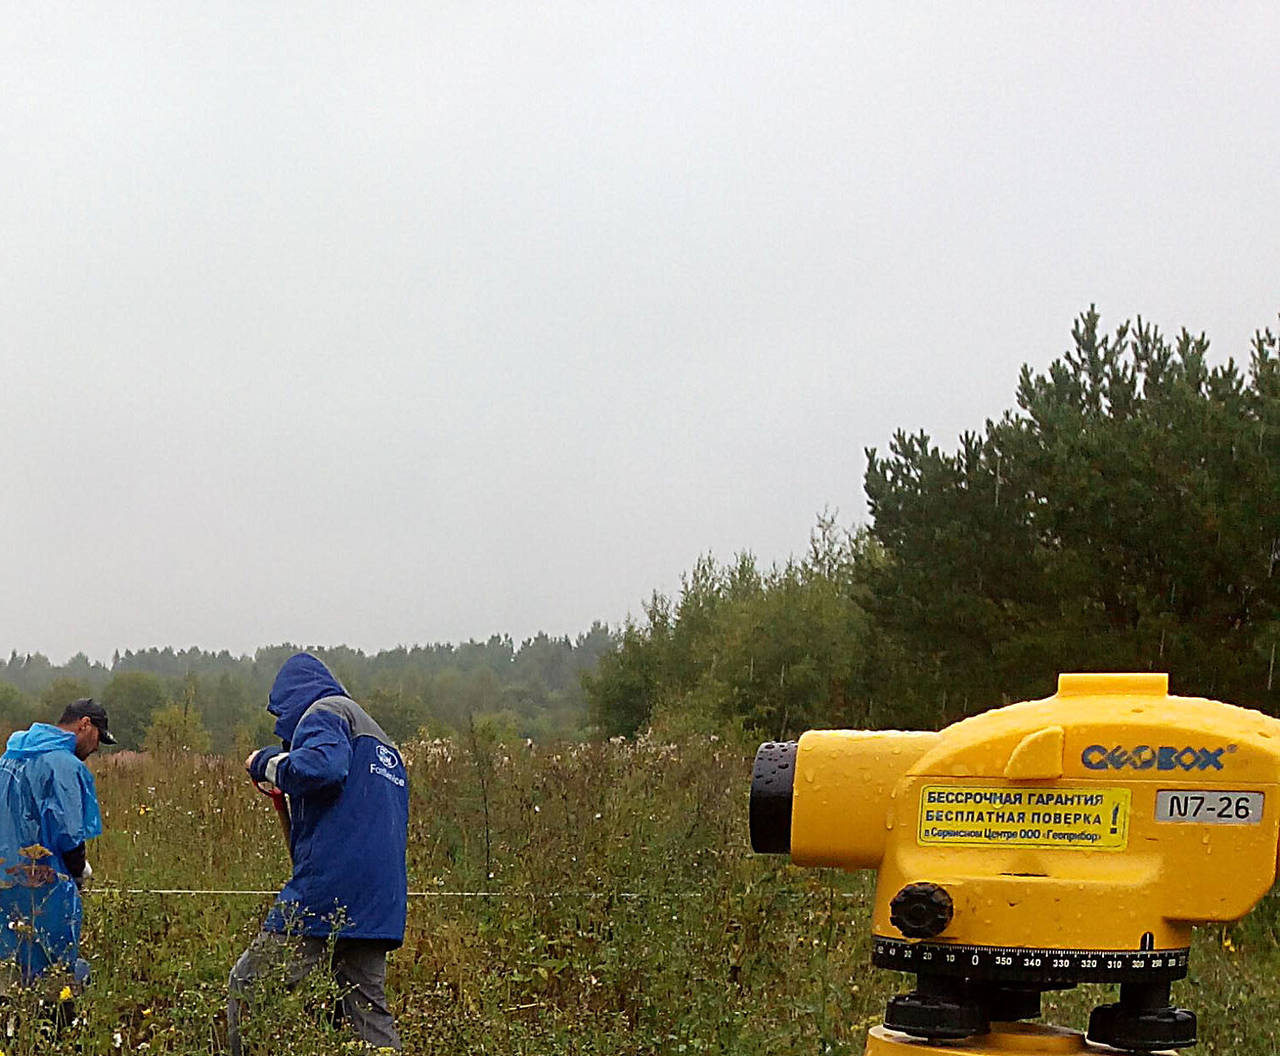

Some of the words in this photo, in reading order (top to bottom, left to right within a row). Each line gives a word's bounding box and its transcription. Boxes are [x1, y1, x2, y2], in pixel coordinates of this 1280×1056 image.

[927, 791, 1023, 805] БЕССРОЧНАЯ
[1028, 793, 1104, 806] ГАРАНТИЯ
[1169, 795, 1250, 820] N7-26
[926, 810, 1026, 824] БЕСПЛАТНАЯ
[1031, 812, 1102, 825] ПОВЕРКА
[1019, 829, 1041, 839] ООО
[923, 952, 933, 960] 20
[946, 954, 955, 962] 10
[972, 955, 979, 966] 0
[995, 956, 1012, 966] 350
[1023, 958, 1041, 967] 340
[1053, 959, 1070, 968] 330
[1081, 960, 1097, 968] 320
[1107, 960, 1122, 969] 310
